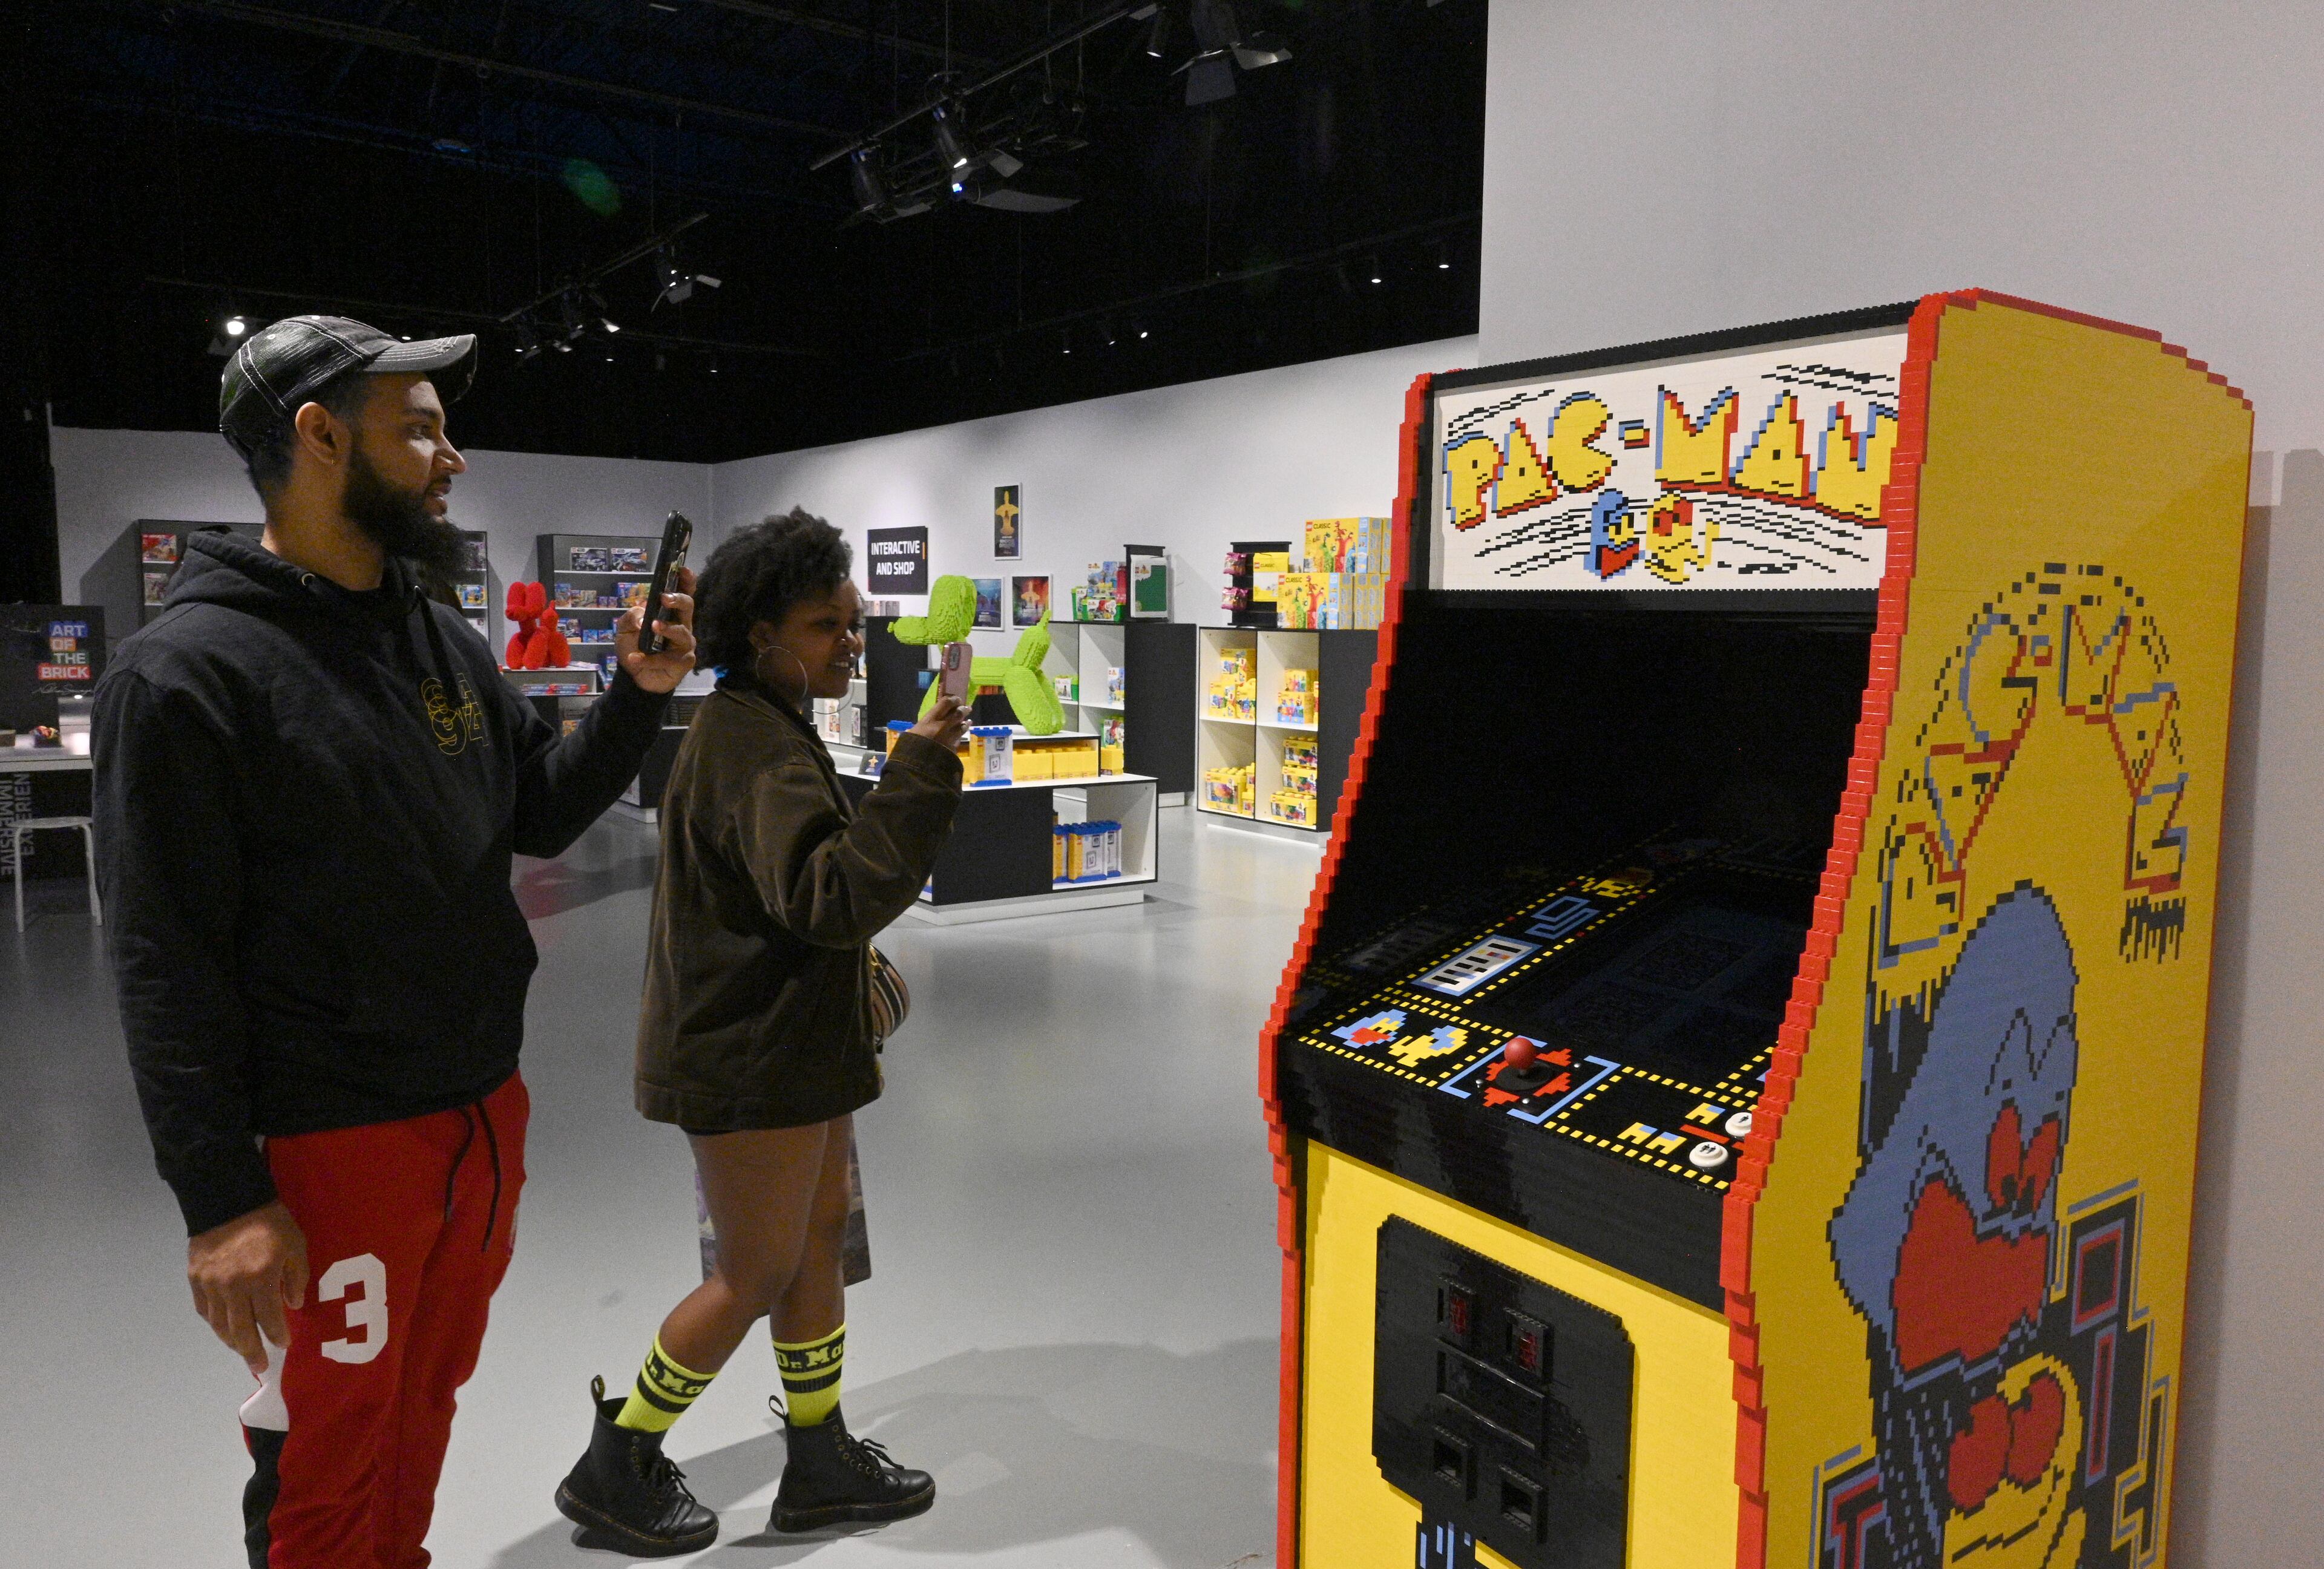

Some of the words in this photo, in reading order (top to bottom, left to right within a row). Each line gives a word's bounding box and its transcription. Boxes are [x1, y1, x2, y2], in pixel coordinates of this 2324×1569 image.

[1442, 384, 1899, 531] PAC-MAN
[871, 540, 921, 555] INTERACTIVE
[876, 562, 893, 575] AND
[893, 562, 915, 575] SHOP
[51, 624, 85, 637] ART
[52, 638, 74, 650] OF
[53, 652, 86, 664] THE
[41, 666, 89, 679] BRICK
[14, 773, 34, 856] EXERIEN
[318, 1252, 389, 1364] 3
